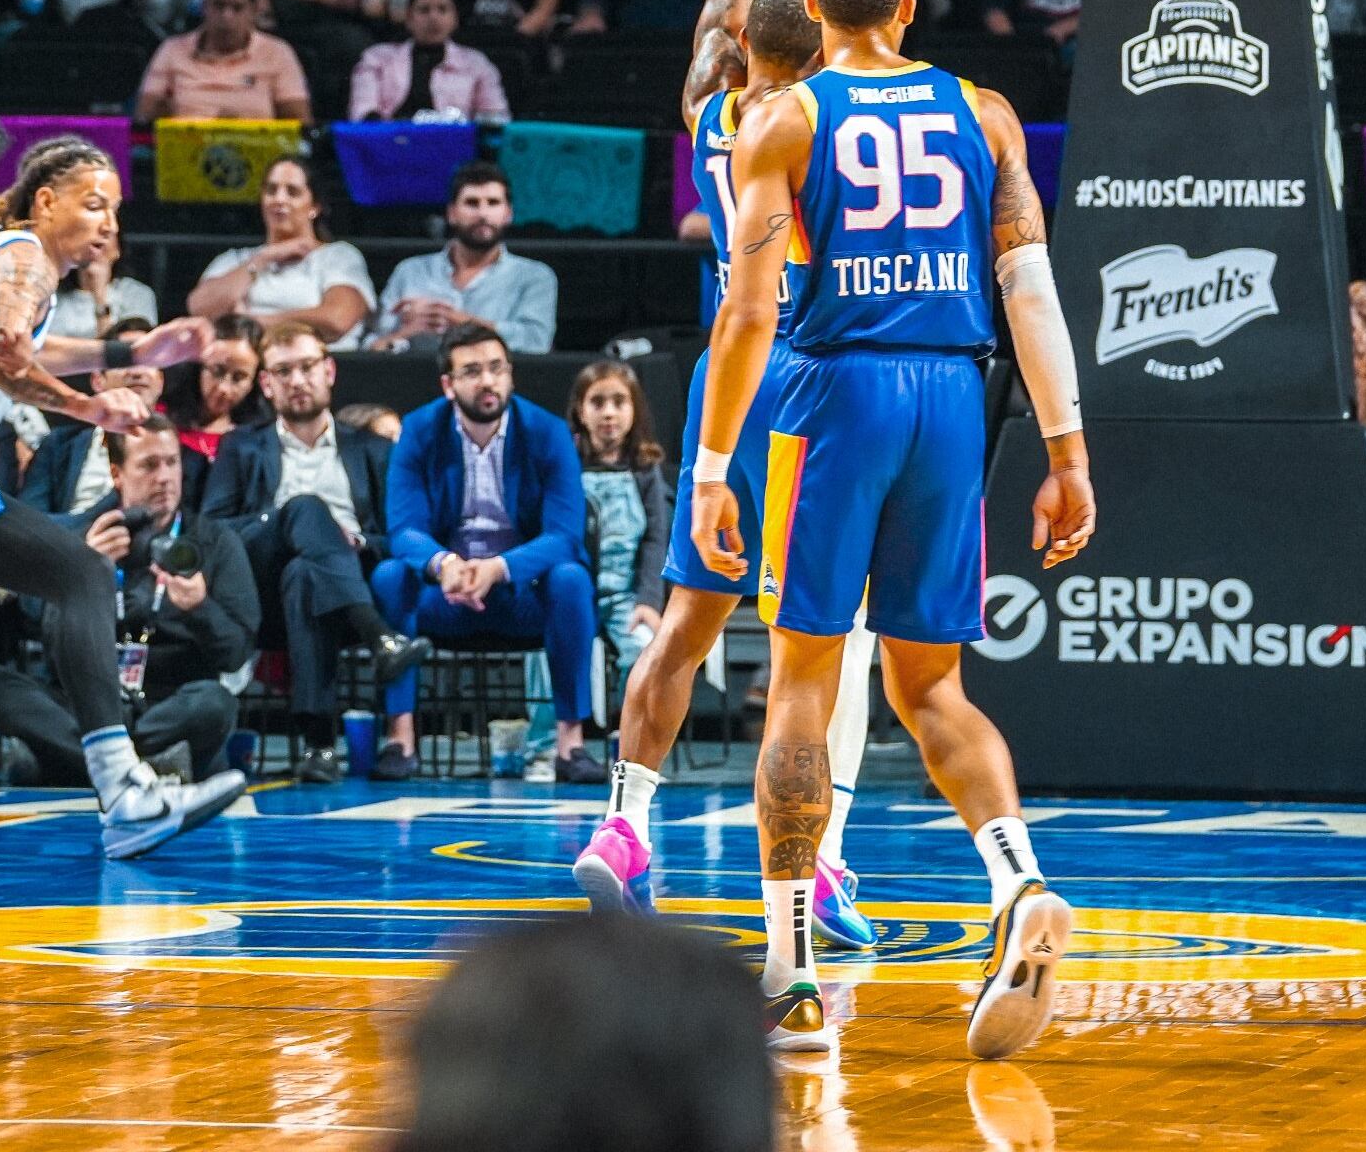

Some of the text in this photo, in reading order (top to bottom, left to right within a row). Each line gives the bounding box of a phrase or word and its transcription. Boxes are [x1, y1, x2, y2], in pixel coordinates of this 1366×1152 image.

[1130, 32, 1260, 73] CAPITANES
[834, 113, 965, 231] 95
[832, 252, 969, 298] TOSCANO
[1111, 265, 1255, 332] French's
[1056, 575, 1254, 621] GRUPO
